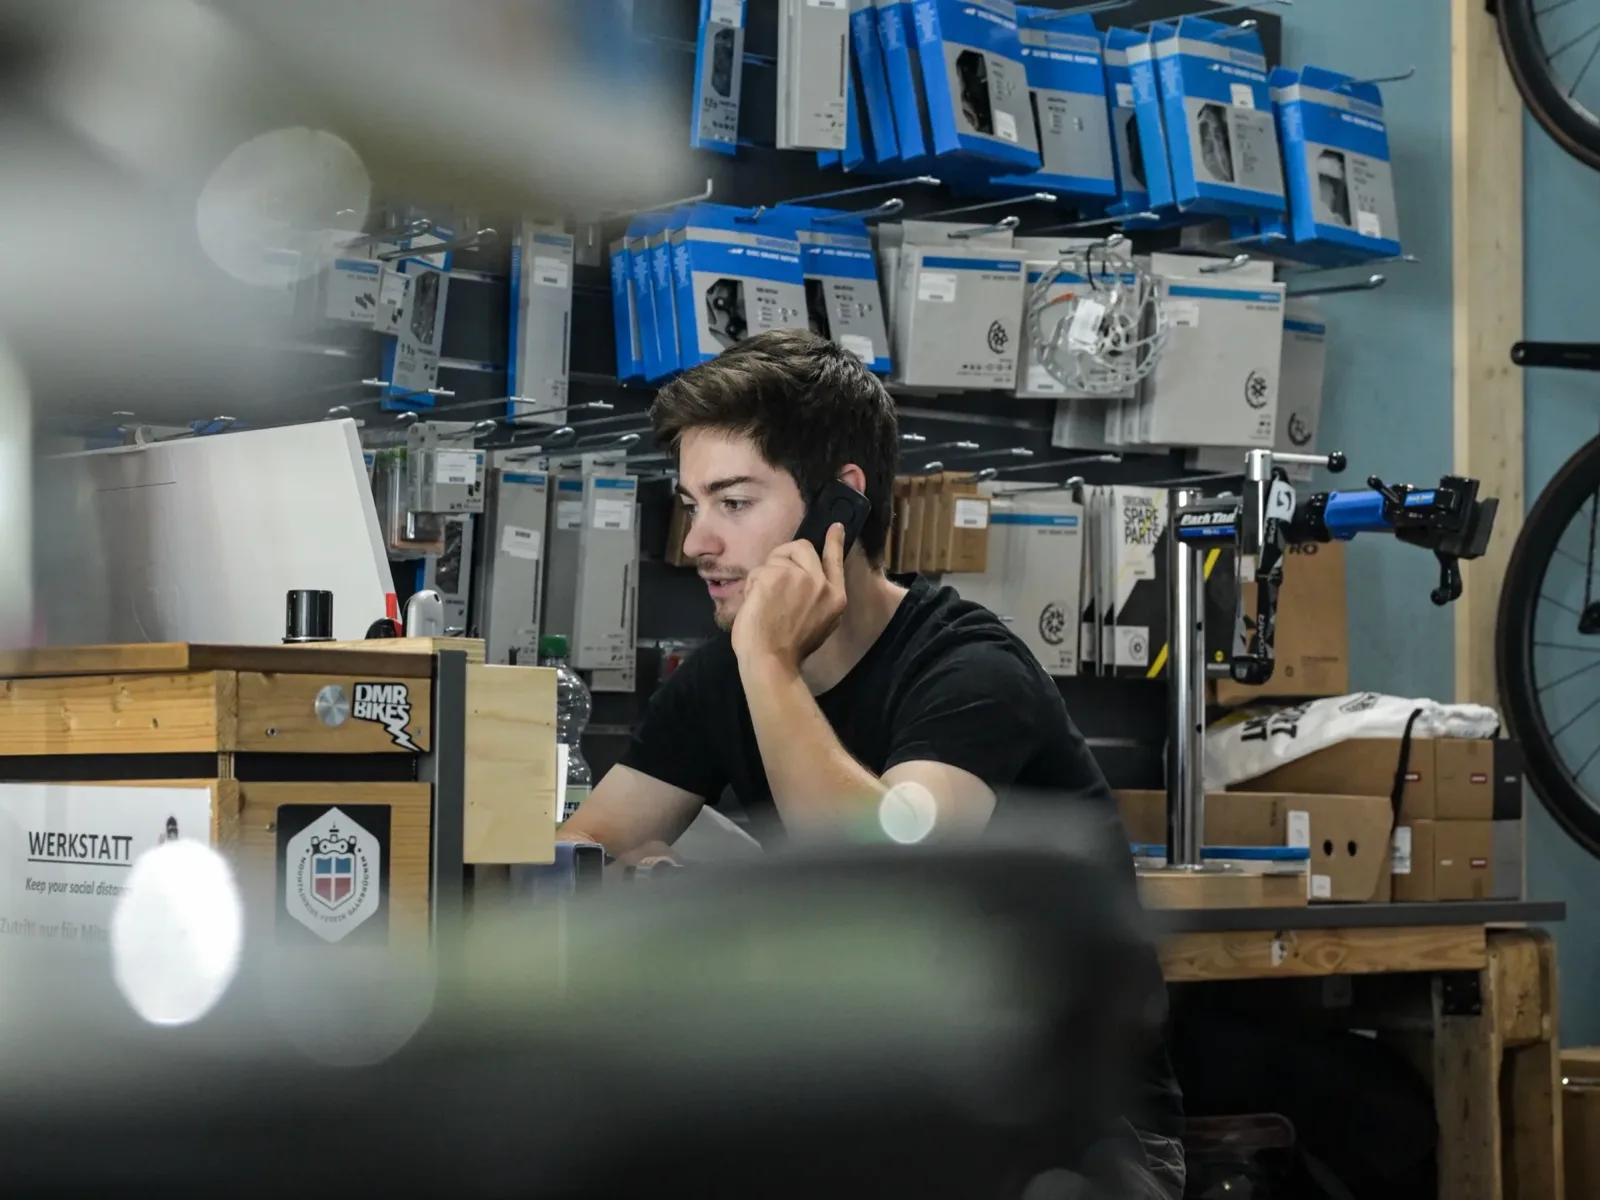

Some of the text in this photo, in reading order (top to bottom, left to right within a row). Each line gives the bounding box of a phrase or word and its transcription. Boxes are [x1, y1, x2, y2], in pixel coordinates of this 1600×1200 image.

[1124, 507, 1159, 526] SPARE
[1180, 513, 1212, 526] Park
[1124, 526, 1159, 545] PARTS
[355, 684, 408, 705] DMR
[353, 701, 410, 724] BIKES
[28, 831, 133, 860] WERKSTATT
[25, 877, 46, 894] Keep
[48, 881, 69, 895] your
[70, 881, 95, 896] social
